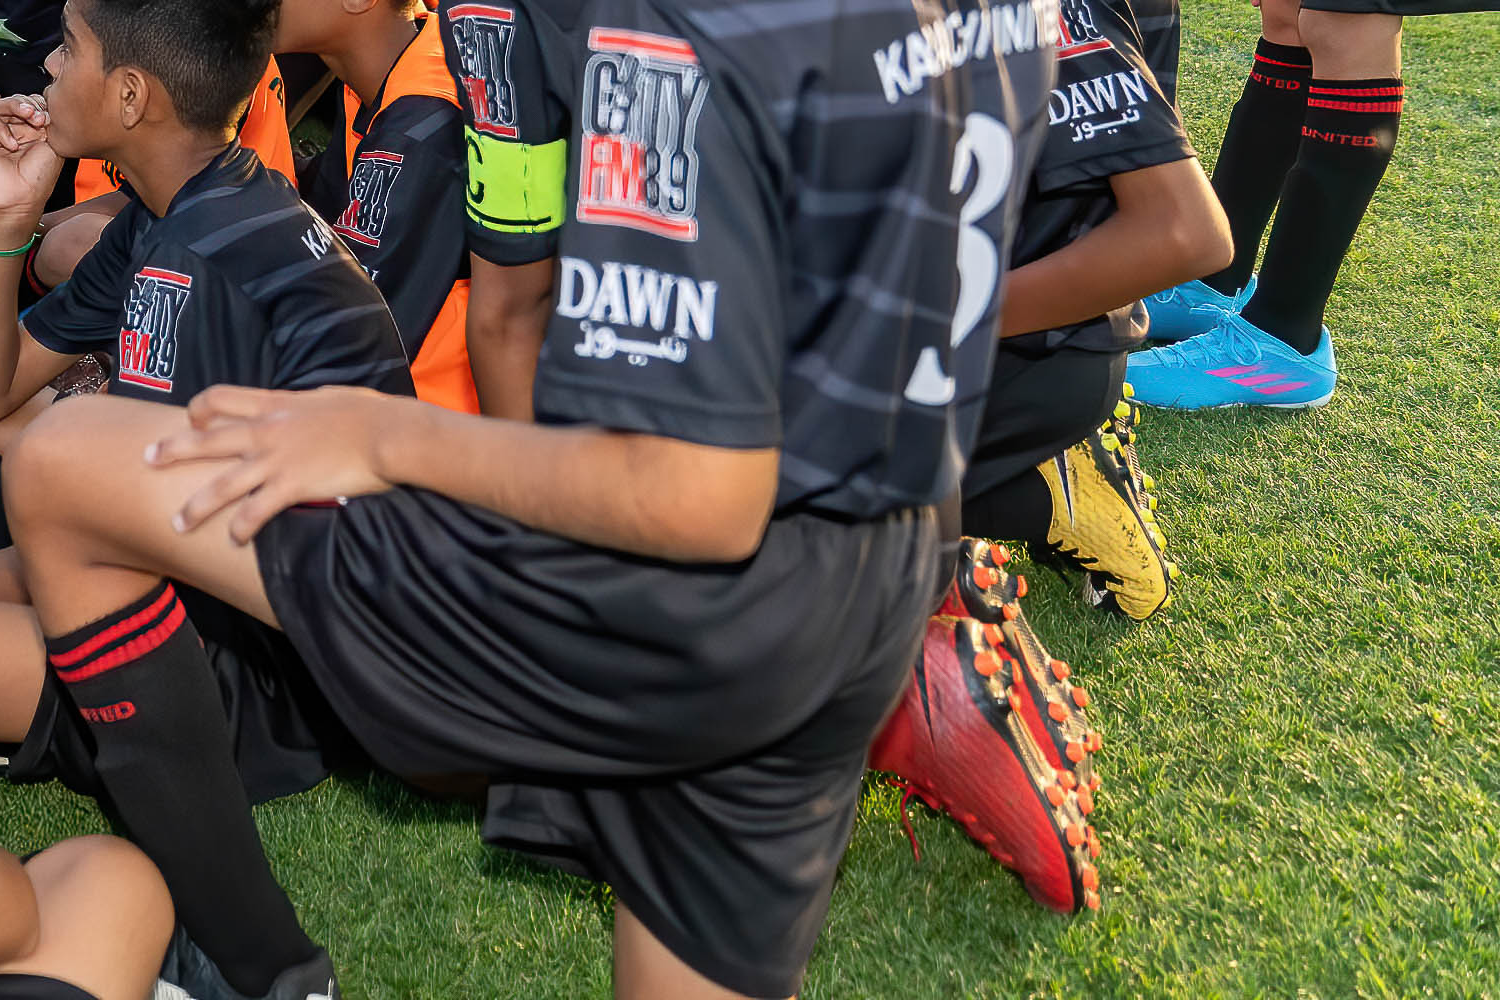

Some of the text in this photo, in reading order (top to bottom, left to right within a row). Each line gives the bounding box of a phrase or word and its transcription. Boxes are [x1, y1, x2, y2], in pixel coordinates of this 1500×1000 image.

[582, 51, 710, 152] CITY
[1049, 67, 1149, 126] DAWN
[465, 135, 485, 205] C
[1301, 125, 1378, 148] UNITED
[580, 132, 700, 218] FM89
[556, 255, 719, 341] DAWN
[119, 328, 178, 379] FM89
